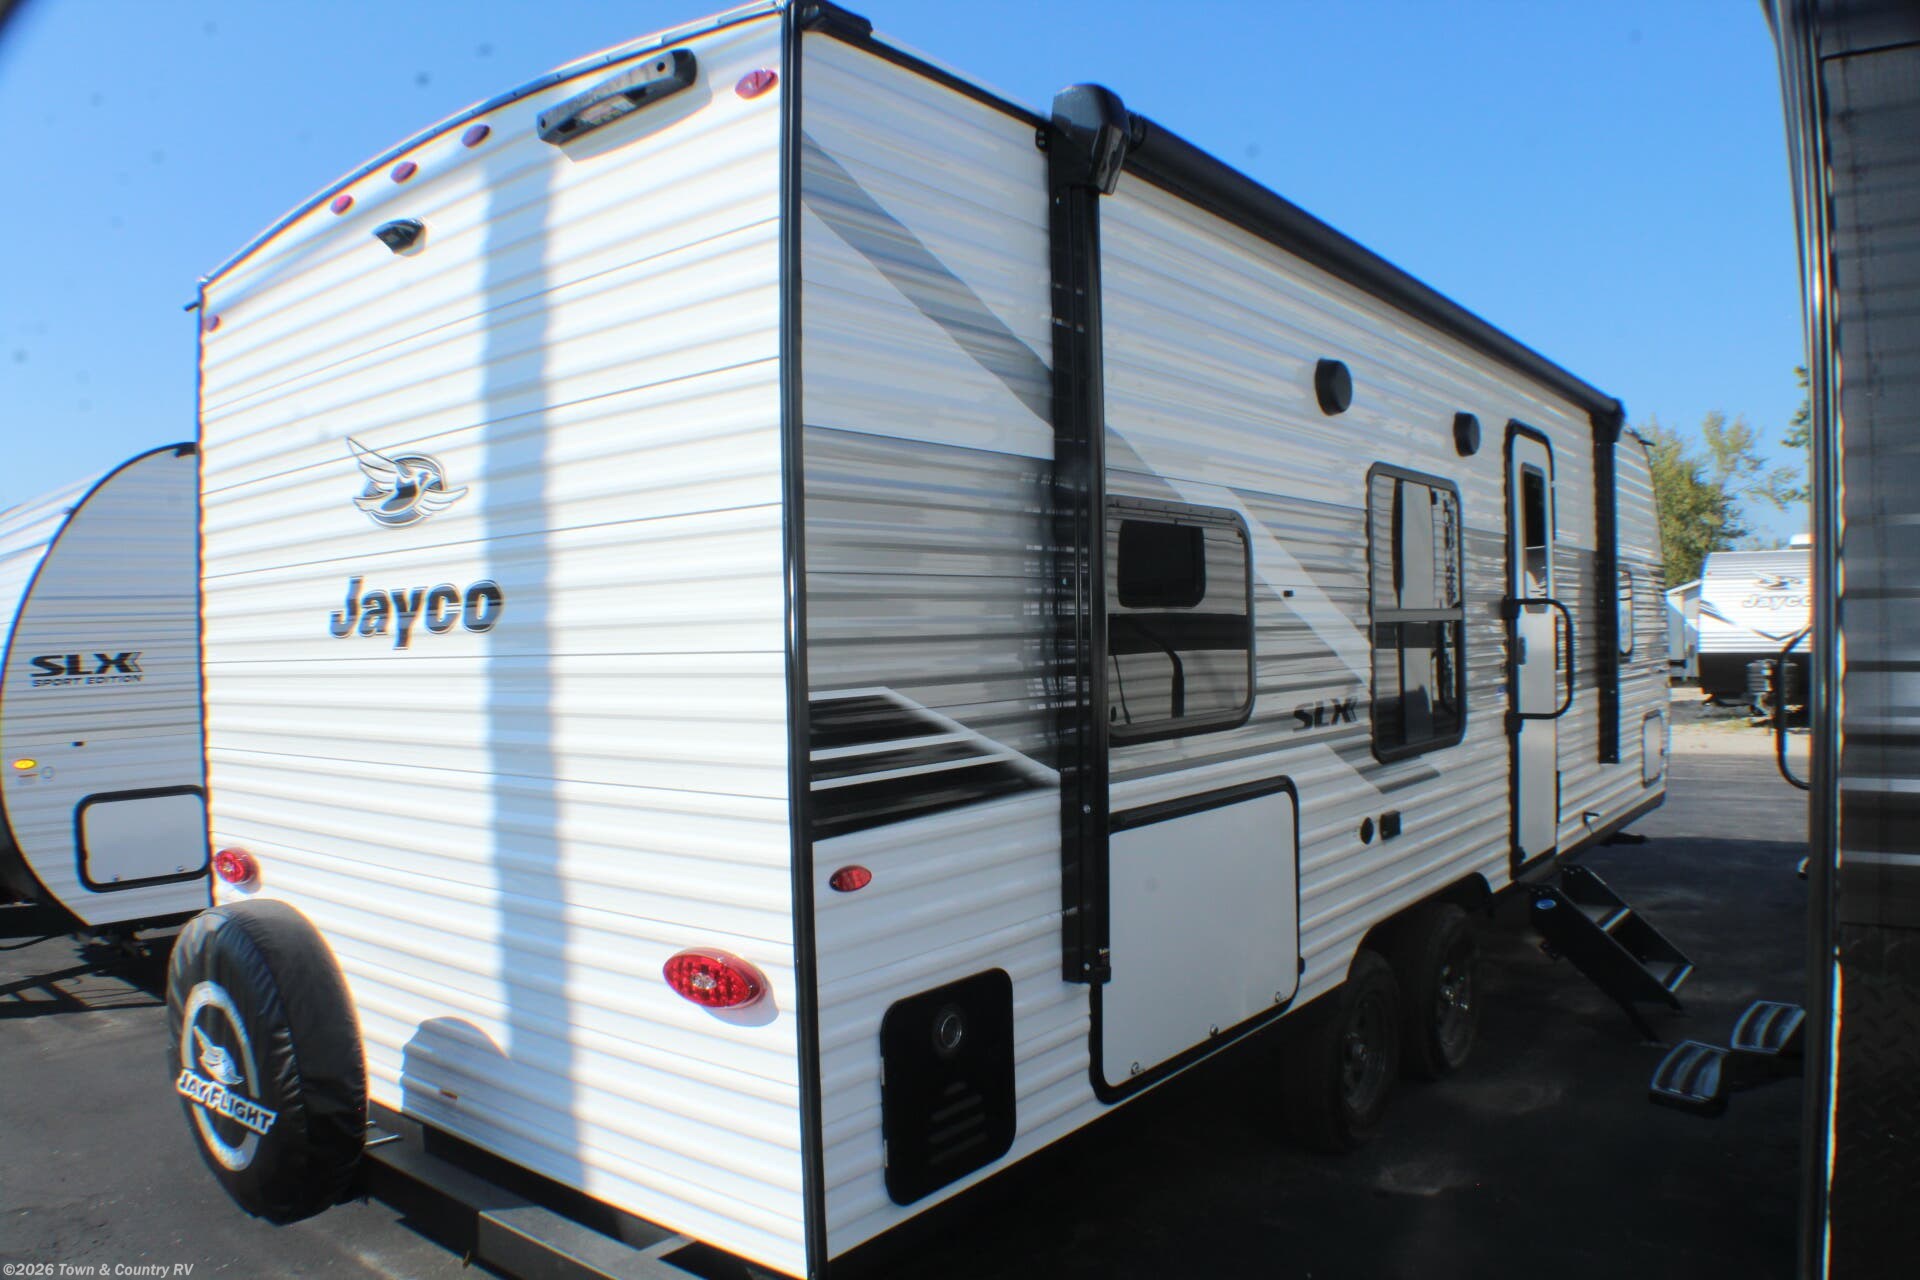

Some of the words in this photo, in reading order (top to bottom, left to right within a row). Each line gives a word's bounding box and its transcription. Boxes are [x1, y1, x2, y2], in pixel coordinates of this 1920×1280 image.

[329, 576, 504, 650] Jayco
[30, 652, 144, 677] SLX
[32, 677, 83, 687] SPORT
[86, 675, 143, 685] EDITION
[1293, 696, 1358, 732] SLX
